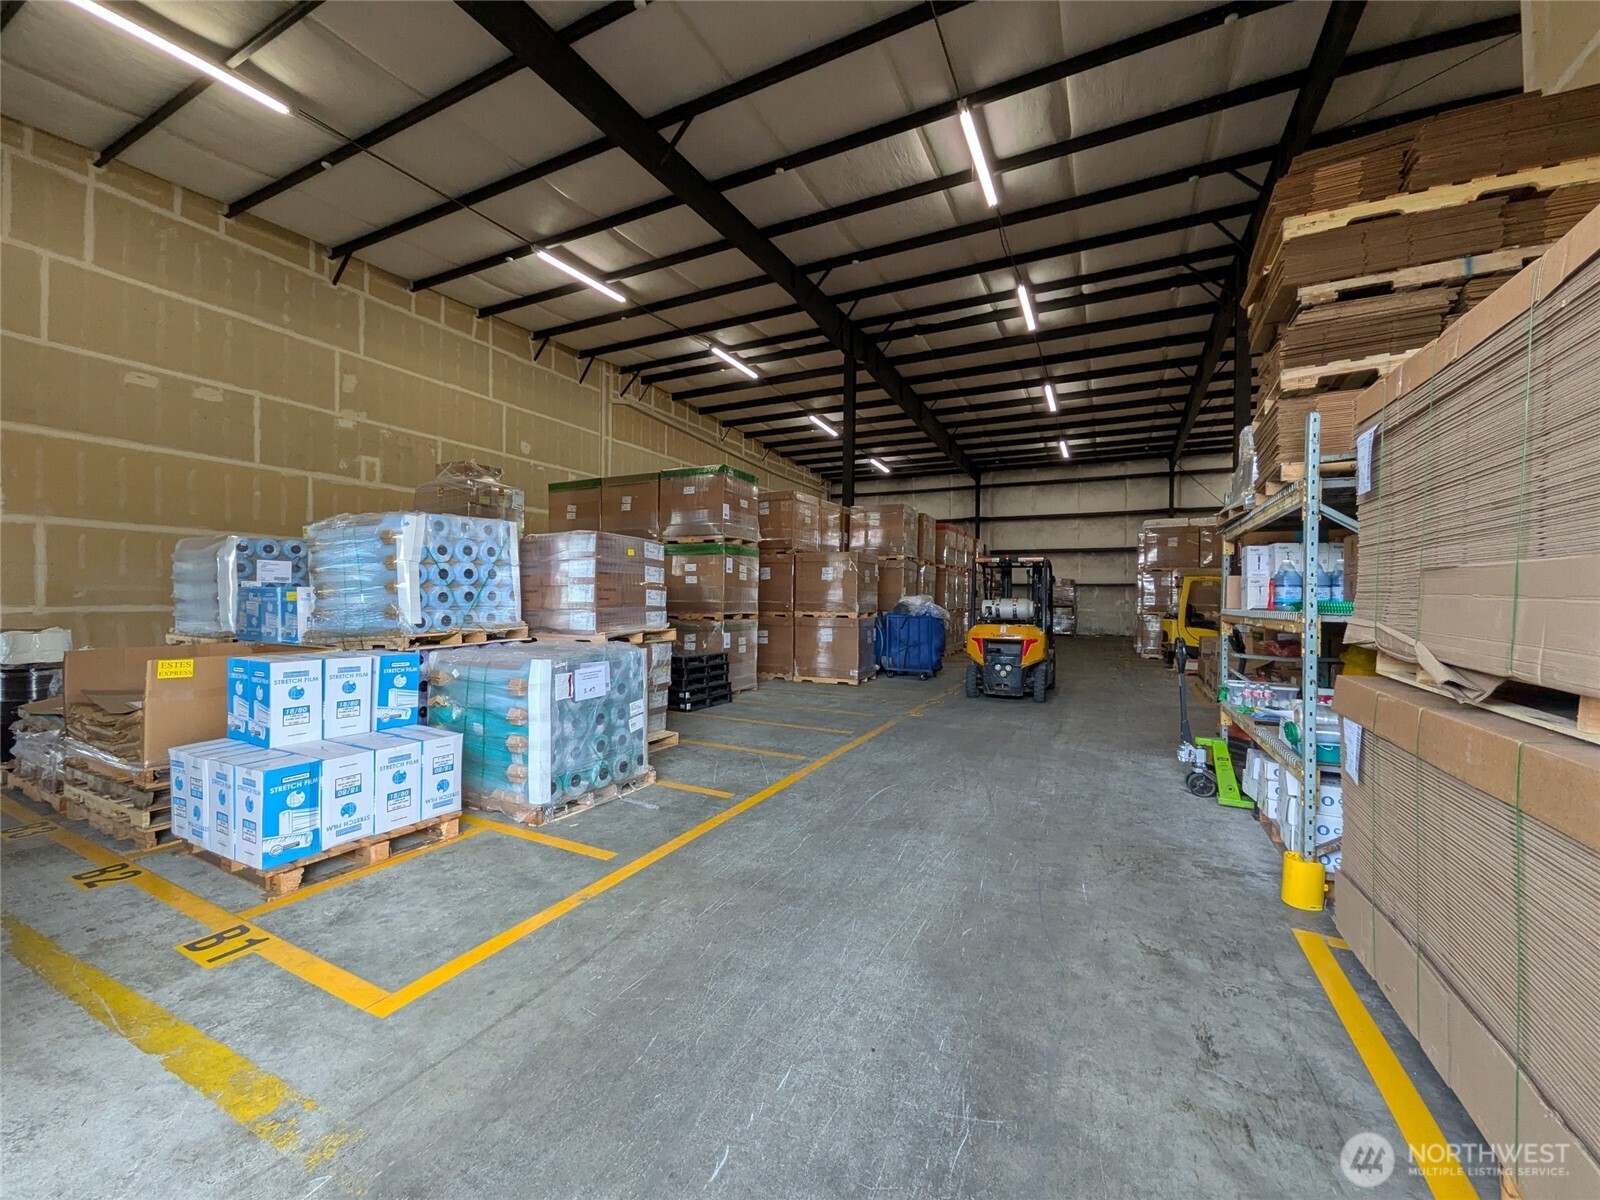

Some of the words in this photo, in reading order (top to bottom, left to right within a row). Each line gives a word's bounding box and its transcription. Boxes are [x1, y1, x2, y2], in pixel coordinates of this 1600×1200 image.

[161, 661, 192, 669] ESTES
[274, 677, 303, 686] STRETCH
[379, 762, 405, 771] STRETCH
[269, 782, 303, 794] STRETCH
[343, 815, 371, 826] STRETCH
[71, 862, 143, 888] B2
[183, 924, 270, 963] B1
